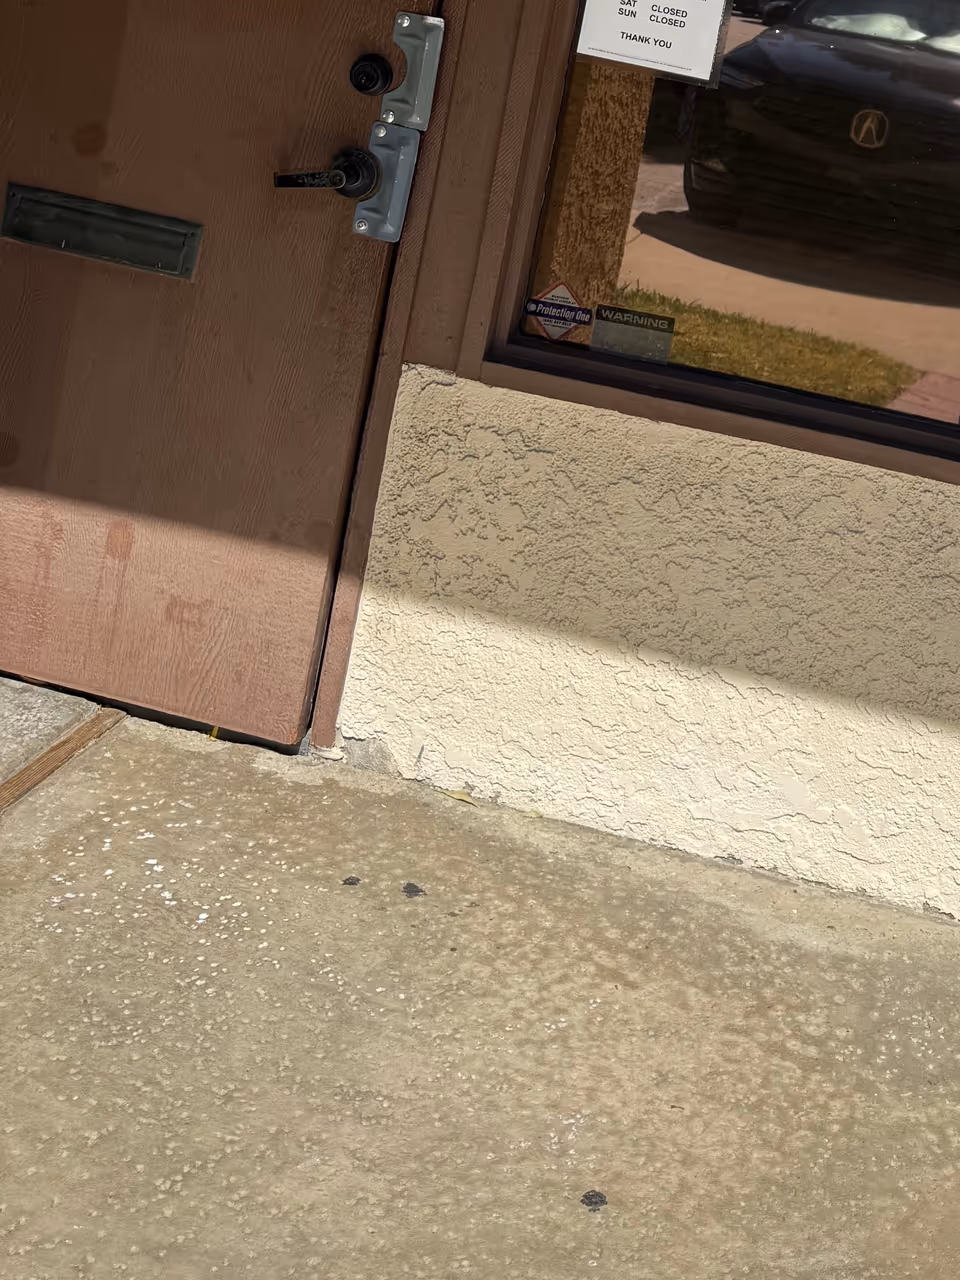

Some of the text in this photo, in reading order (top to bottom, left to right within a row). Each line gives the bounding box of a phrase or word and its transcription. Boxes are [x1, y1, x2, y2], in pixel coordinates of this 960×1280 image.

[618, 7, 686, 28] SUN CLOSED
[651, 4, 688, 18] CLOSED
[620, 31, 673, 49] THANK YOU
[536, 303, 591, 322] Protection One
[601, 308, 669, 329] WARNING
